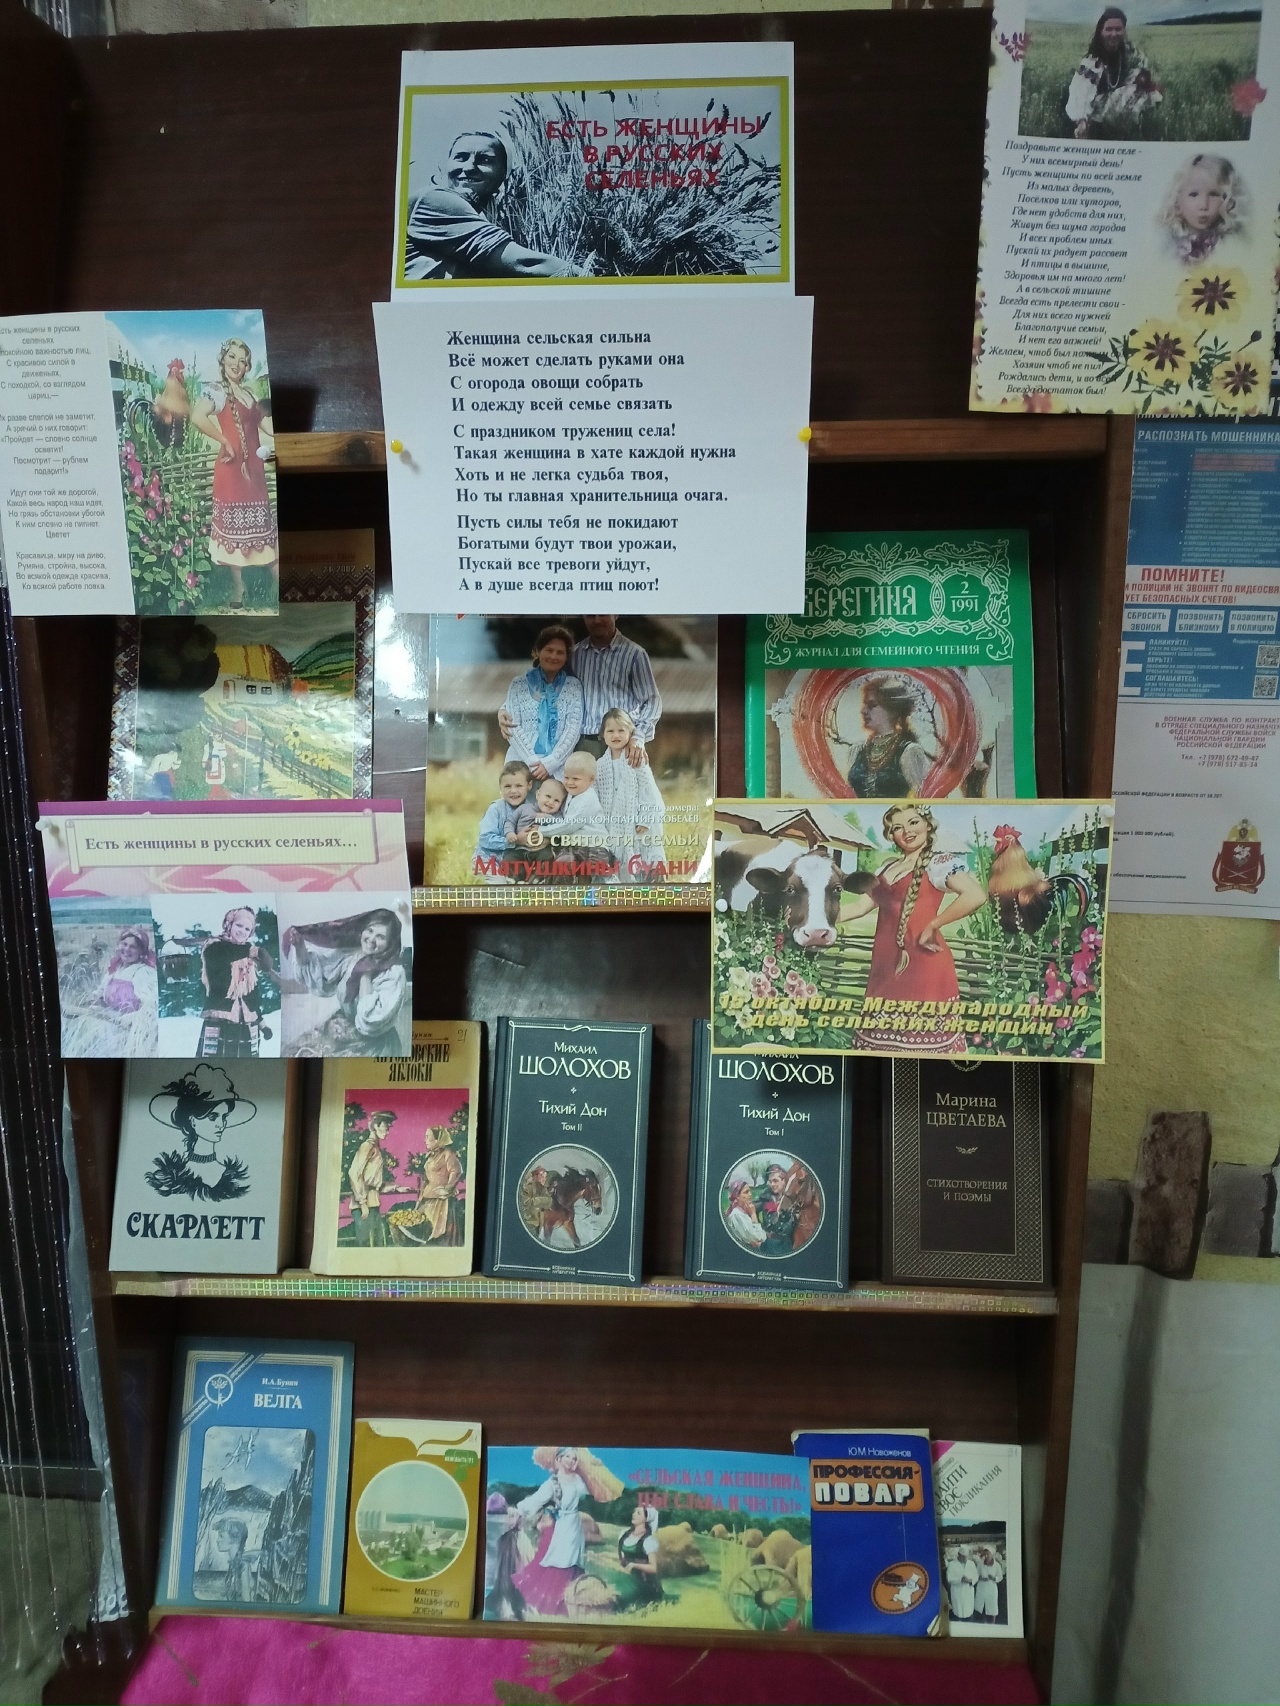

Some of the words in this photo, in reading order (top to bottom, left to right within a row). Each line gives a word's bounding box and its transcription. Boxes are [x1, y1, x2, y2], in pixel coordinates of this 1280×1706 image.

[547, 120, 608, 139] ЕСТЬ
[616, 116, 762, 138] ЖЕНЩИНЫ
[584, 146, 598, 164] В
[606, 143, 722, 163] РУССКИХ
[1005, 140, 1061, 152] Поздравьте
[1062, 146, 1101, 156] женщин
[1103, 147, 1115, 155] на
[585, 169, 721, 190] СЕЛЕНЬЯХ
[1010, 219, 1043, 231] Живут
[1045, 219, 1059, 230] без
[1061, 223, 1087, 232] шума
[1089, 221, 1126, 234] городов
[1004, 271, 1045, 281] Здоровья
[1074, 275, 1102, 283] много
[1103, 274, 1126, 282] лет!
[446, 330, 521, 346] Женщина
[526, 333, 593, 344] сельская
[599, 332, 651, 343] сильна
[448, 352, 475, 367] Всё
[481, 356, 529, 367] может
[535, 355, 592, 368] сделать
[598, 355, 652, 369] руками
[658, 354, 684, 365] она
[450, 375, 461, 389] С
[467, 378, 525, 393] огорода
[531, 378, 579, 390] овощи
[585, 373, 643, 392] собрать
[451, 397, 465, 411] И
[471, 400, 525, 414] одежду
[530, 397, 563, 411] всей
[568, 400, 611, 410] семье
[616, 399, 672, 410] связать
[453, 424, 464, 438] С
[470, 427, 555, 441] праздником
[561, 426, 633, 440] тружениц
[638, 422, 675, 437] села!
[1138, 431, 1207, 441] РАСПОЗНАТЬ
[453, 445, 497, 459] Такая
[503, 448, 571, 460] женщина
[577, 448, 585, 459] в
[590, 448, 623, 459] хате
[628, 445, 684, 460] каждой
[690, 448, 736, 461] нужна
[454, 467, 489, 481] Хоть
[495, 471, 504, 481] и
[510, 471, 526, 481] не
[531, 470, 571, 481] легка
[576, 466, 624, 484] судьба
[630, 470, 668, 483] твоя,
[456, 488, 478, 502] Но
[483, 492, 502, 502] ты
[508, 492, 563, 502] главная
[569, 491, 678, 505] хранительница
[684, 491, 727, 501] очага.
[457, 514, 500, 531] Пусть
[506, 518, 542, 528] силы
[547, 514, 579, 528] тебя
[586, 518, 602, 528] не
[607, 518, 678, 530] покидают
[457, 536, 529, 549] Богатыми
[534, 536, 574, 553] будут
[579, 540, 612, 549] твои
[618, 540, 676, 553] урожаи,
[458, 556, 511, 573] Пускай
[517, 560, 540, 570] все
[545, 560, 600, 574] тревоги
[605, 557, 650, 574] уйдут,
[1141, 568, 1225, 582] ПОМНИТЕ!
[458, 577, 469, 590] А
[474, 581, 482, 590] в
[487, 581, 523, 594] душе
[529, 581, 573, 592] всегда
[579, 581, 613, 592] птиц
[618, 577, 658, 591] поют!
[961, 582, 969, 594] 2
[1132, 583, 1171, 592] ПОЛИЦИИ
[1174, 584, 1183, 592] НЕ
[1186, 584, 1218, 592] ЗВОНЯТ
[1221, 585, 1232, 593] ПО
[952, 599, 978, 612] 1991
[1143, 594, 1199, 603] БЕЗОПАСНЫХ
[1127, 612, 1166, 620] СБРОСИТЬ
[1131, 623, 1161, 631] ЗВОНОК
[795, 647, 839, 657] ЖУРНАЛ
[841, 647, 862, 657] ДЛЯ
[864, 645, 933, 656] СЕМЕЙНОГО
[935, 644, 980, 655] ЧТЕНИЯ
[658, 814, 699, 823] КОБЕЛЕВ
[85, 838, 119, 851] Есть
[124, 839, 196, 852] женщины
[201, 839, 209, 849] в
[214, 838, 271, 852] русских
[528, 831, 544, 847] О
[550, 833, 636, 847] святости
[641, 833, 699, 846] семьи
[473, 855, 620, 880] Матушкины
[628, 853, 698, 880] будни
[751, 1013, 809, 1029] день
[817, 1015, 937, 1031] сельских
[943, 1018, 1054, 1036] женщин
[554, 1042, 597, 1055] Михаил
[389, 1063, 433, 1082] ЯБЛОКИ
[519, 1055, 631, 1080] ШОЛОХОВ
[718, 1059, 834, 1085] ШОЛОХОВ
[539, 1100, 576, 1116] Тихий
[580, 1102, 607, 1118] Дон
[936, 1093, 997, 1110] Марина
[739, 1105, 778, 1120] Тихий
[782, 1107, 810, 1123] Дон
[927, 1112, 1006, 1128] ЦВЕТАЕВА
[561, 1122, 576, 1132] Том
[765, 1127, 779, 1137] Том
[927, 1179, 1007, 1191] СТИХОТВОРЕНИЯ
[943, 1192, 950, 1200] И
[954, 1192, 991, 1202] ПОЭМЫ
[126, 1211, 265, 1241] СКАРЛЕТТ
[254, 1394, 303, 1410] ВЕЛГА
[868, 1447, 912, 1457] Новоженов
[814, 1482, 914, 1506] ПОВАР
[414, 1588, 442, 1597] МАСТЕР
